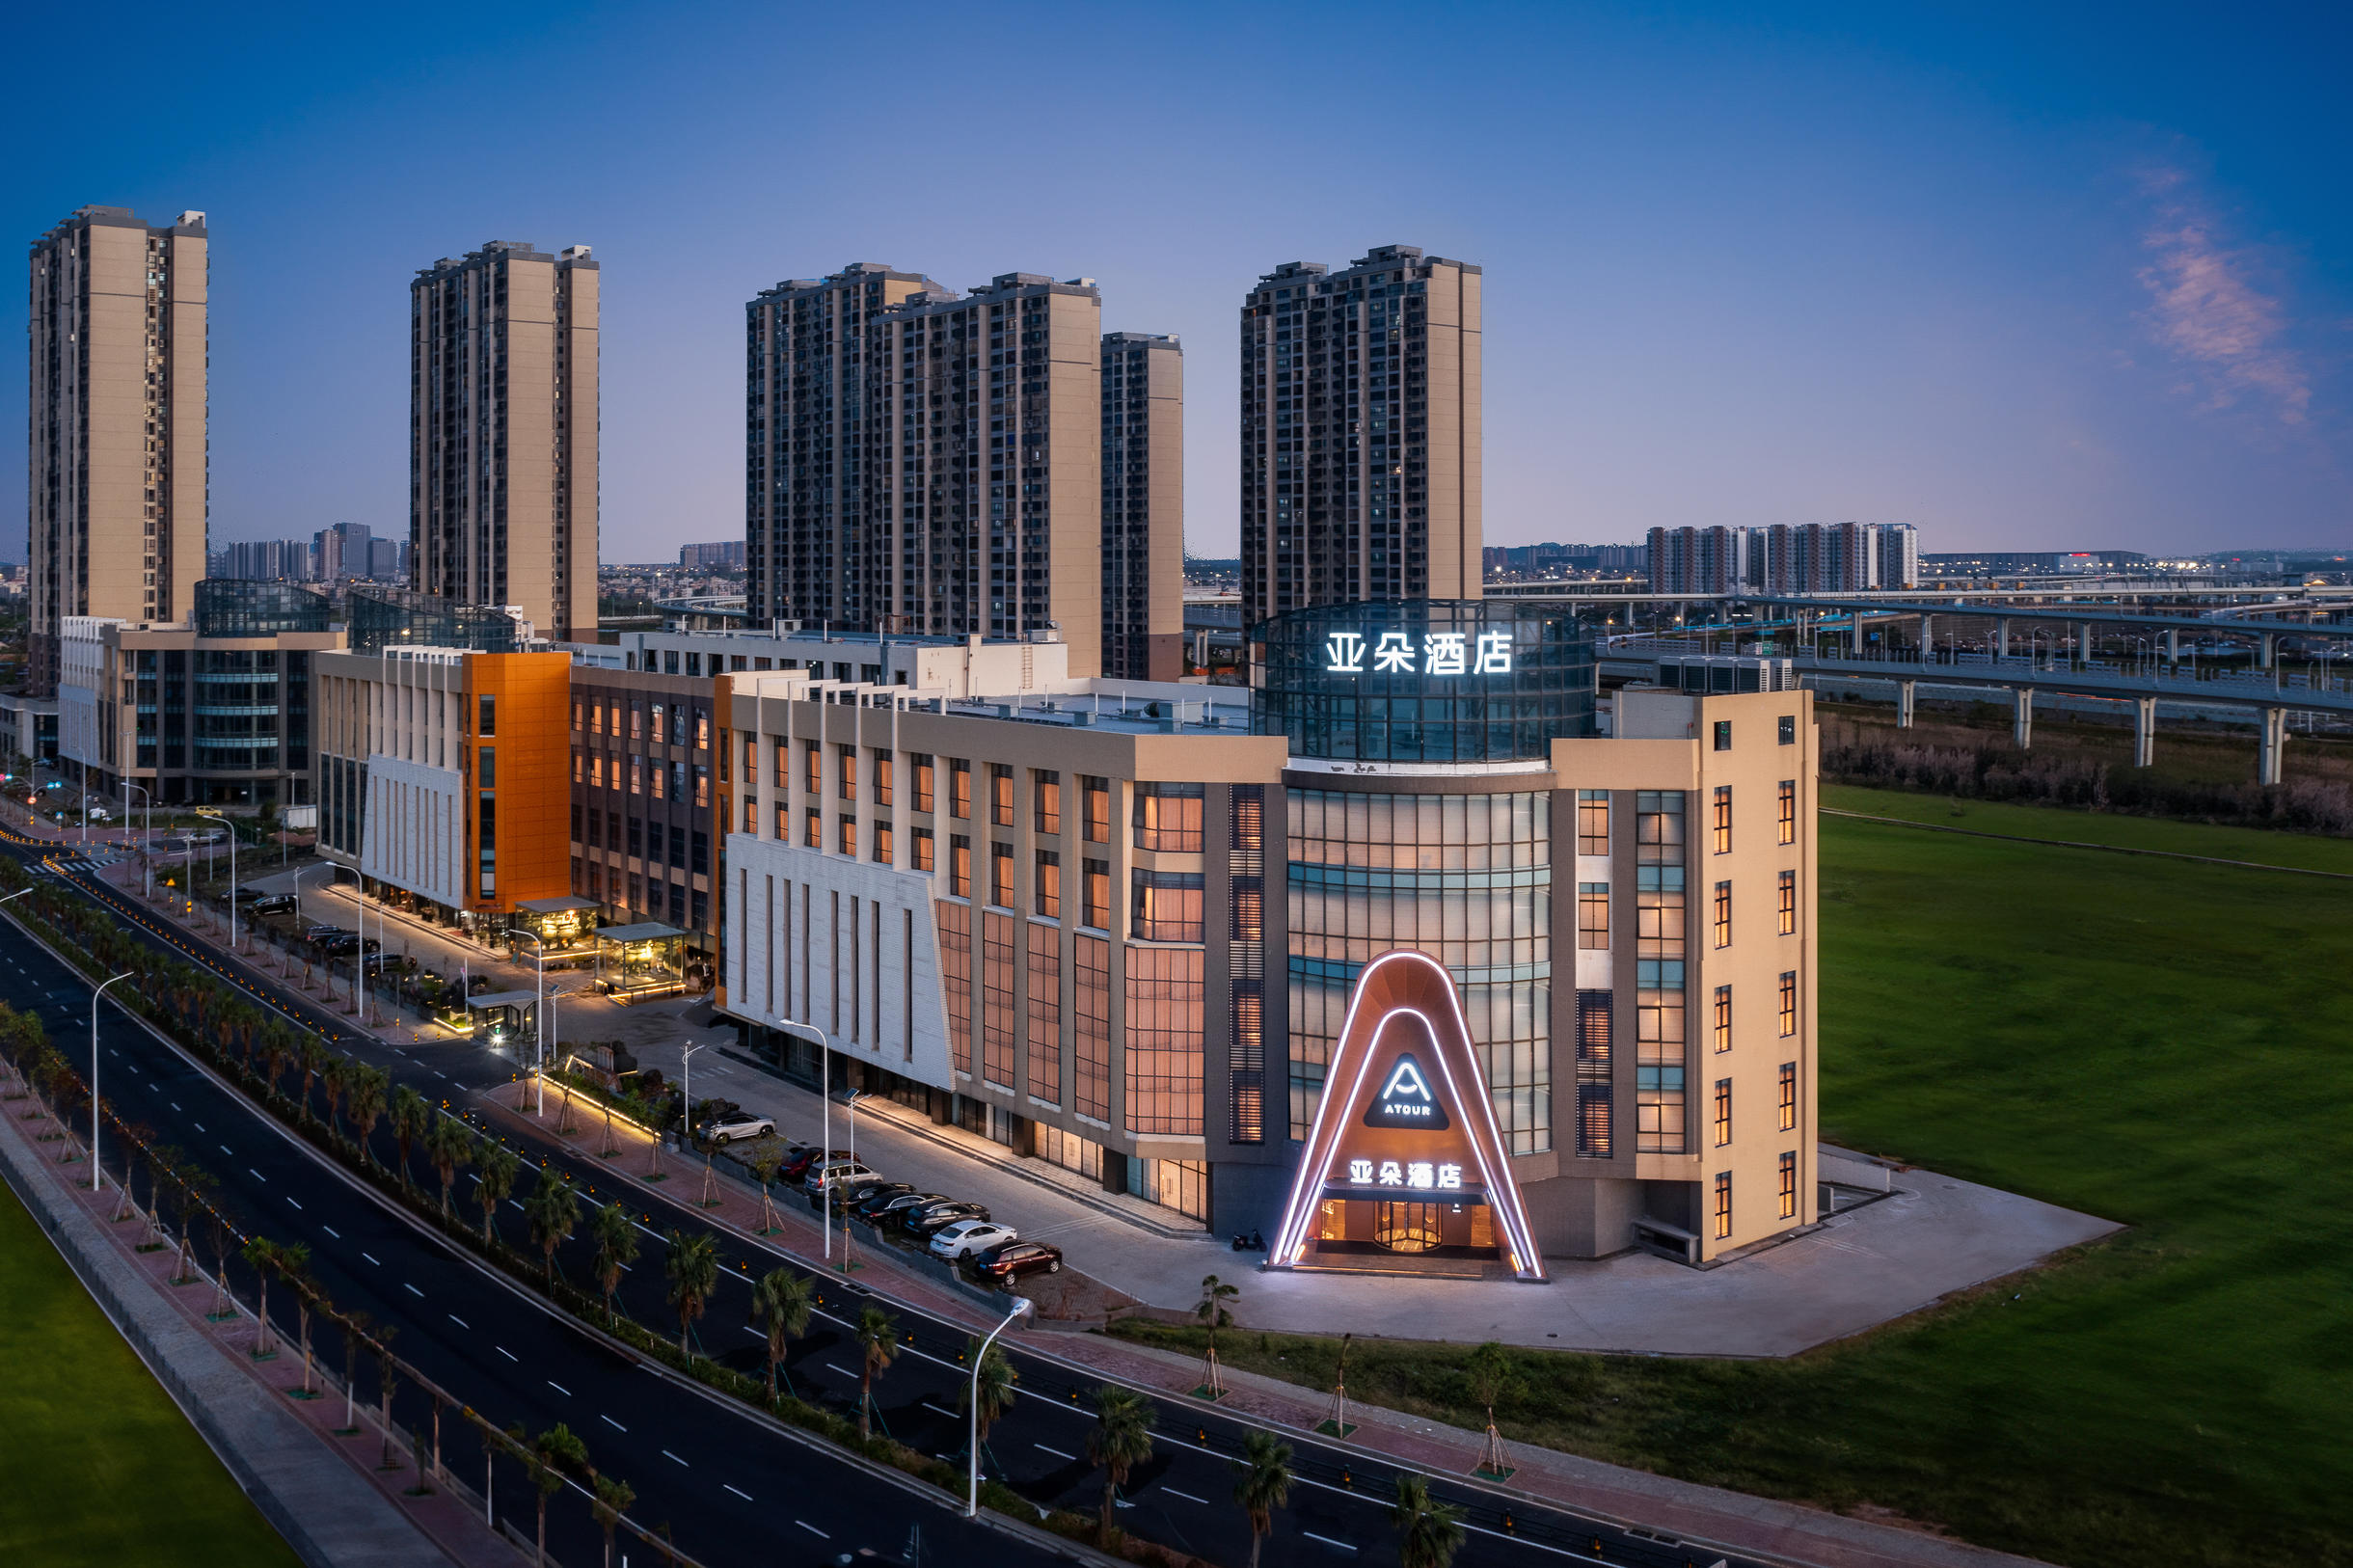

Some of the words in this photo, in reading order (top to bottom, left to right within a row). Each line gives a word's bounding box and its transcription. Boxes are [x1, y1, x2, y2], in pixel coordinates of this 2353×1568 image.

[1326, 630, 1513, 675] 亚朵酒店
[1384, 1103, 1431, 1116] ATOUR
[1349, 1159, 1462, 1189] 亚朵酒店
